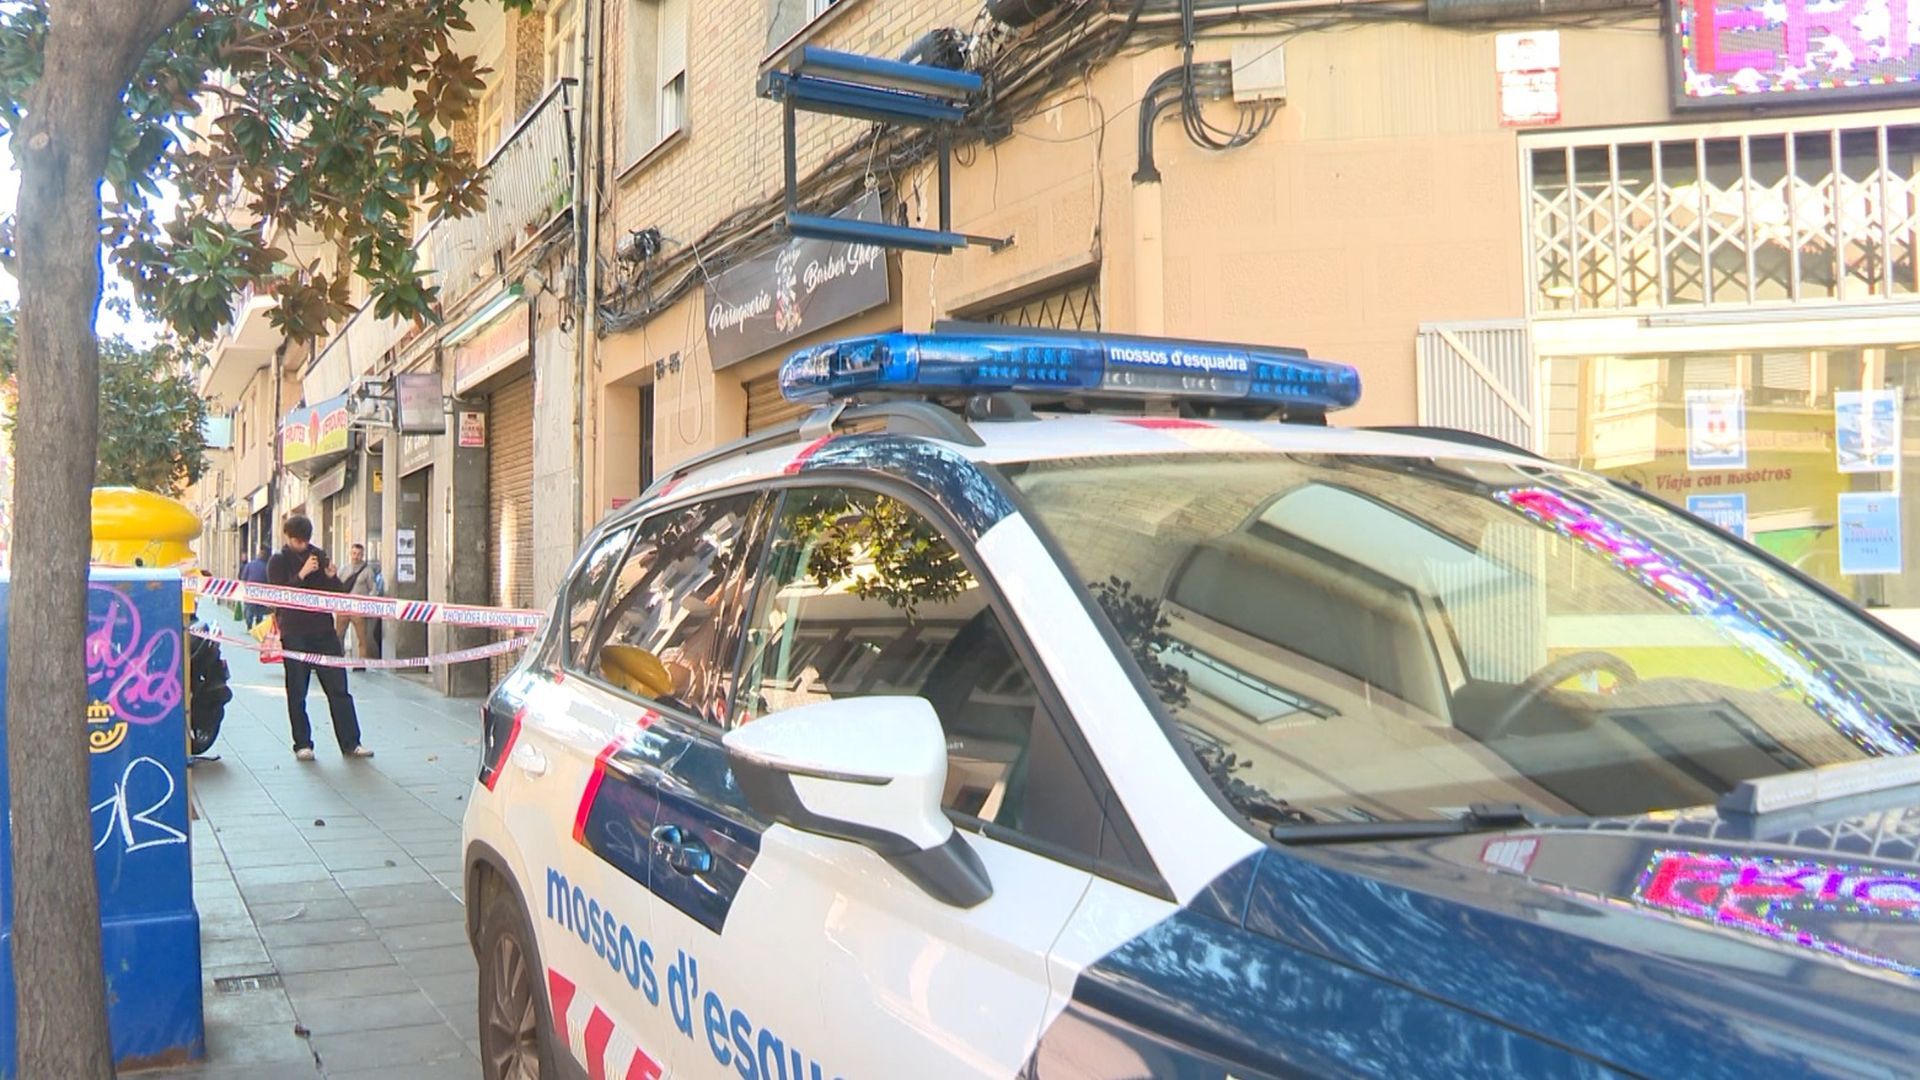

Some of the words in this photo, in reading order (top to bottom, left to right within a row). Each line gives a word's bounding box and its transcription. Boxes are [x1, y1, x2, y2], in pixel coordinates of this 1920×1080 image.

[803, 256, 847, 294] Barber
[1110, 346, 1169, 365] mossos
[1170, 350, 1248, 372] d'esquadra
[1655, 473, 1692, 492] Viaja
[1697, 474, 1722, 488] con
[1727, 467, 1793, 485] nosotros
[546, 866, 660, 1007] mossos
[667, 949, 845, 1080] d'esq
